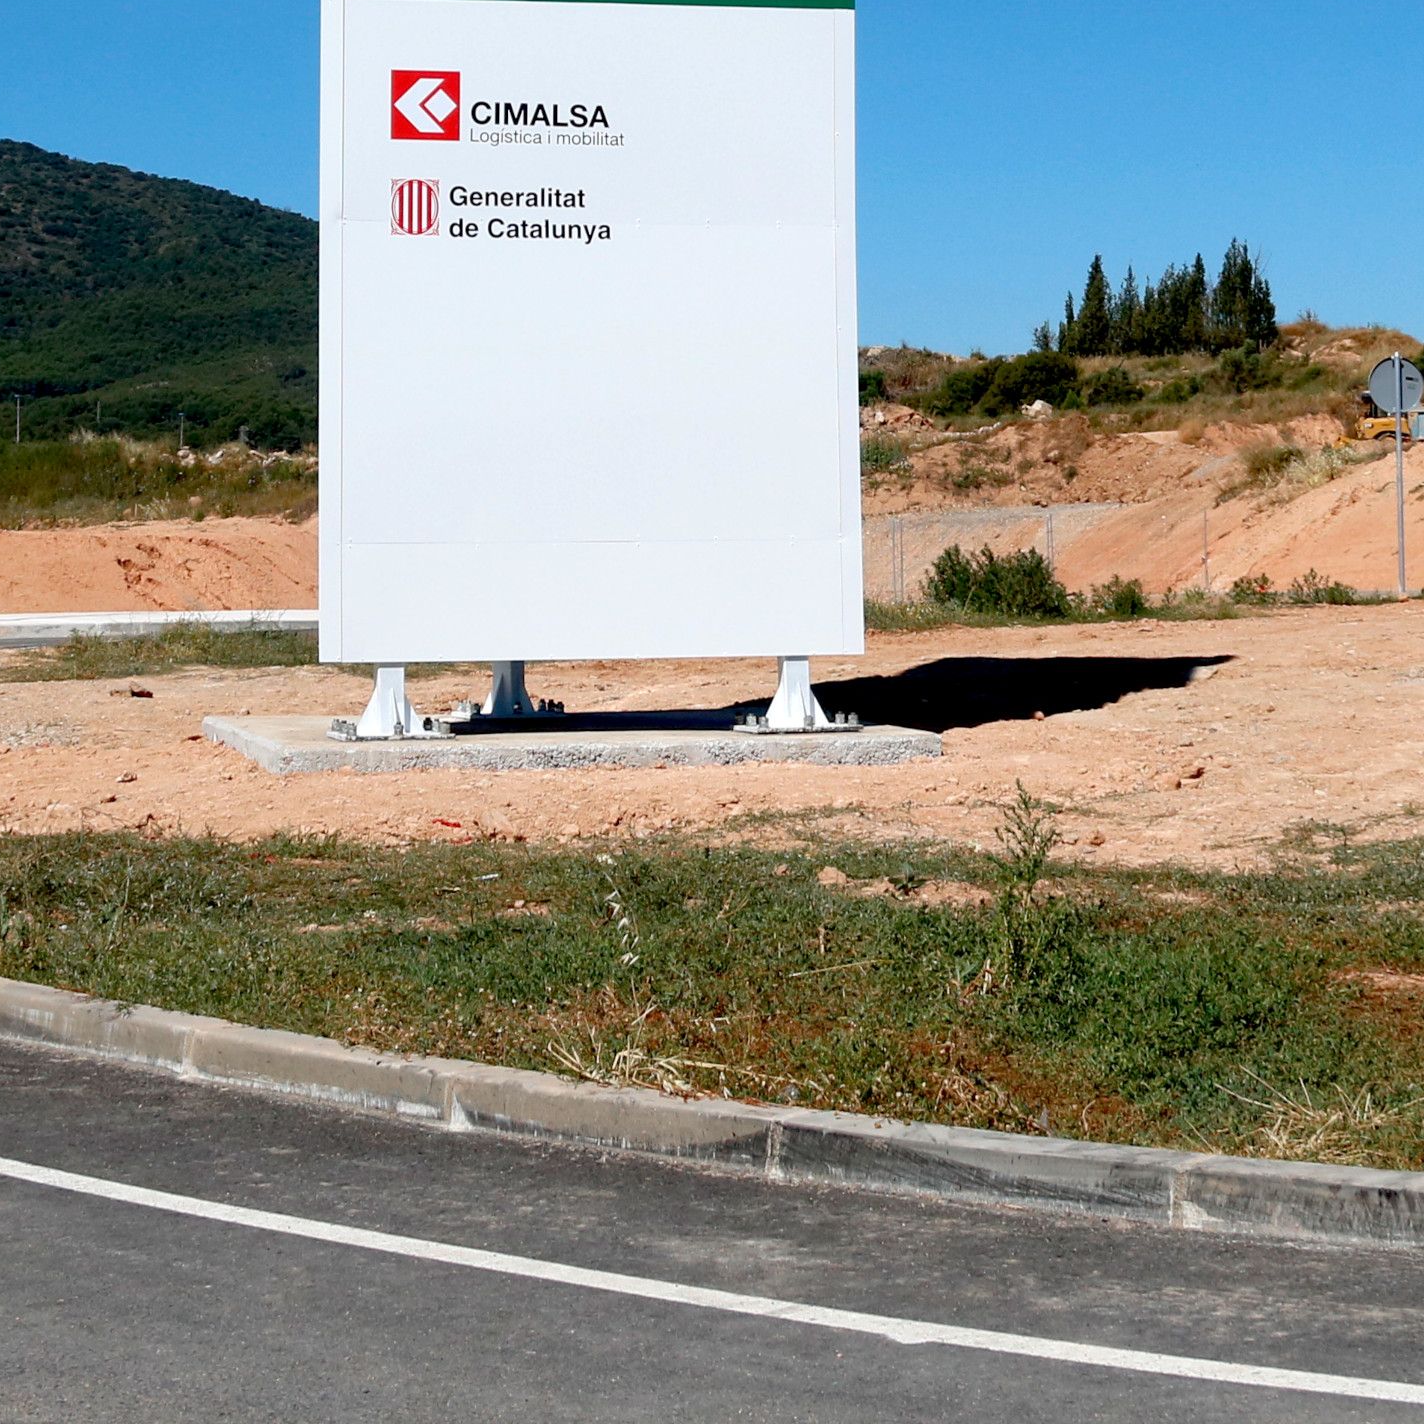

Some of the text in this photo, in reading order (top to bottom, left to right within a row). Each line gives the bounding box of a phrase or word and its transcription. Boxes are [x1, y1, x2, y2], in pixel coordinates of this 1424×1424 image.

[470, 101, 610, 128] CIMALSA
[470, 128, 543, 146] Logística
[556, 132, 624, 146] mobilitat
[449, 186, 586, 208] Generalitat
[449, 218, 611, 245] de Catalunya
